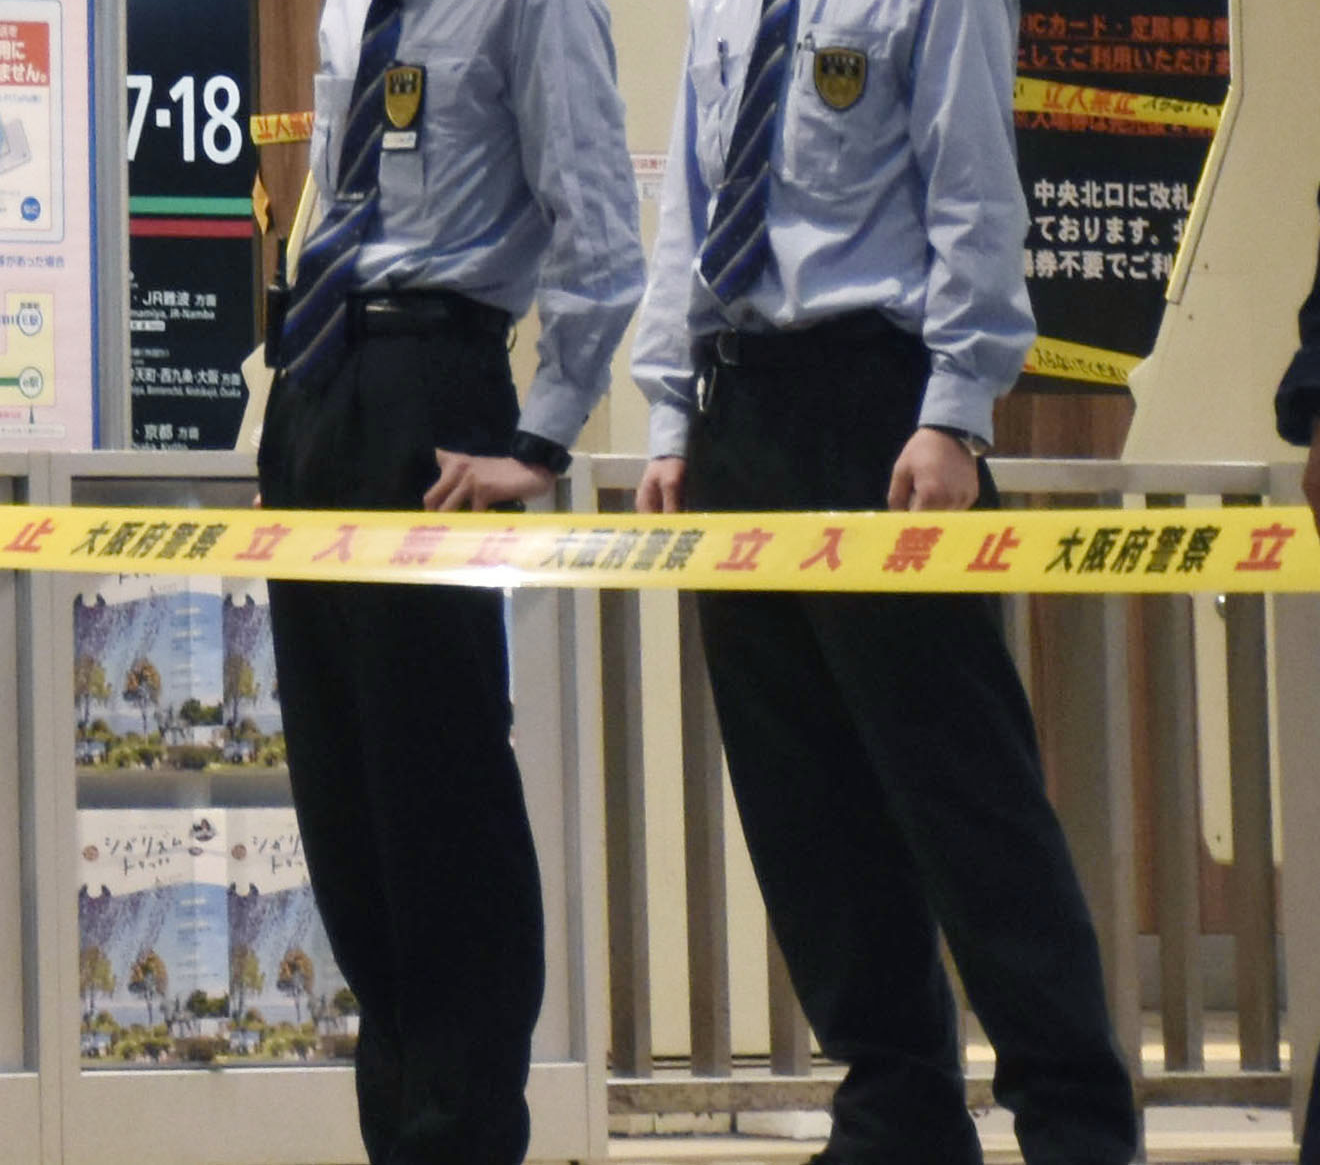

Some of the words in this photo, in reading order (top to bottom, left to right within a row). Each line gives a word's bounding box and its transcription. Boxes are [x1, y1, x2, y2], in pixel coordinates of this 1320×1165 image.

[71, 521, 228, 561] 大阪府警察
[234, 523, 523, 567] 立入禁止
[539, 527, 706, 572] 大阪府警察
[714, 526, 1021, 574] 立入禁止
[1044, 525, 1221, 576] 大阪府警察
[1233, 522, 1295, 573] 立
